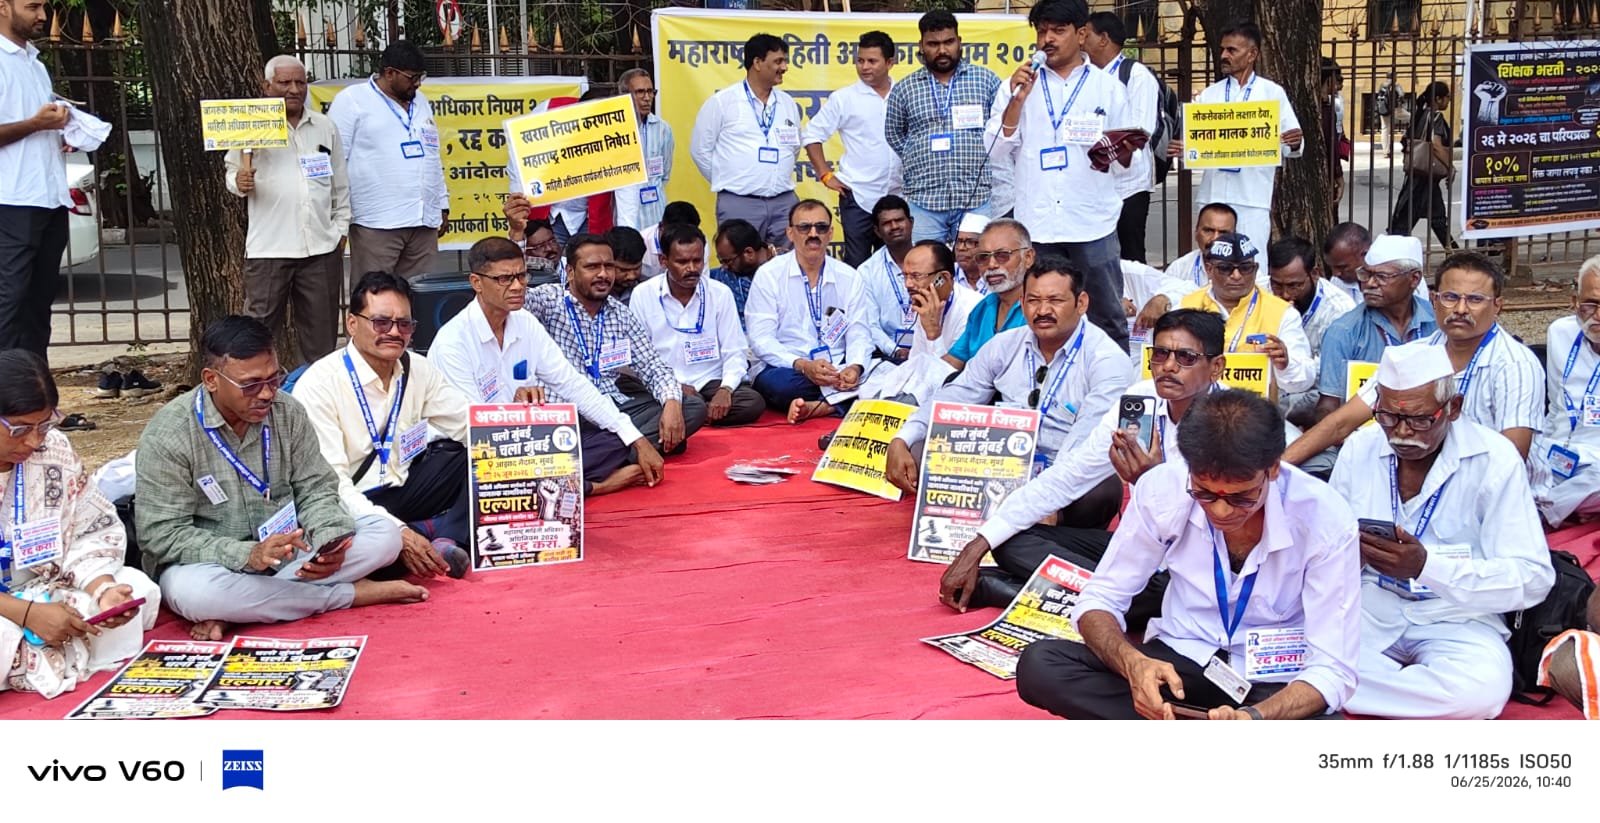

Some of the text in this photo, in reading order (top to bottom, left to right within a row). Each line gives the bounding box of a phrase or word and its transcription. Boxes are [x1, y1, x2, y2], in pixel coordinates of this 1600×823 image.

[782, 33, 831, 68] हिती
[996, 43, 1038, 64] २०२
[1497, 63, 1534, 78] शिक्षक
[1536, 60, 1564, 76] भरती
[1575, 65, 1600, 74] २०२
[487, 95, 524, 116] नियम
[1235, 111, 1257, 120] लक्षात
[458, 129, 506, 151] रद्द क
[520, 125, 549, 144] खराब
[550, 119, 580, 137] नियम
[1190, 129, 1216, 140] जनता
[1219, 127, 1248, 139] मालक
[1251, 122, 1271, 139] आहे
[1482, 135, 1495, 148] २६
[1497, 131, 1506, 145] मे
[1509, 133, 1537, 146] २०२६
[1552, 128, 1591, 141] परिपत्रक
[522, 149, 560, 168] महाराष्ट्र
[561, 140, 604, 159] शासनाचा
[604, 132, 630, 150] निषेध
[449, 161, 509, 179] आंदोल
[1485, 156, 1519, 175] १०%
[545, 177, 563, 191] माहिती
[564, 174, 583, 188] अधिकार
[474, 193, 491, 203] २५
[495, 193, 511, 204] जू
[1233, 368, 1263, 381] वापरा
[475, 407, 570, 423] अकोला जिल्हा
[938, 407, 1033, 428] अकोला जिल्हा
[491, 429, 509, 441] चलो
[950, 428, 968, 439] चलो
[499, 437, 550, 456] चला मुंबई
[955, 438, 1006, 456] चला मुंबई
[479, 493, 538, 514] एल्गार!
[926, 489, 983, 508] एल्गार!
[1046, 563, 1089, 591] अकोल
